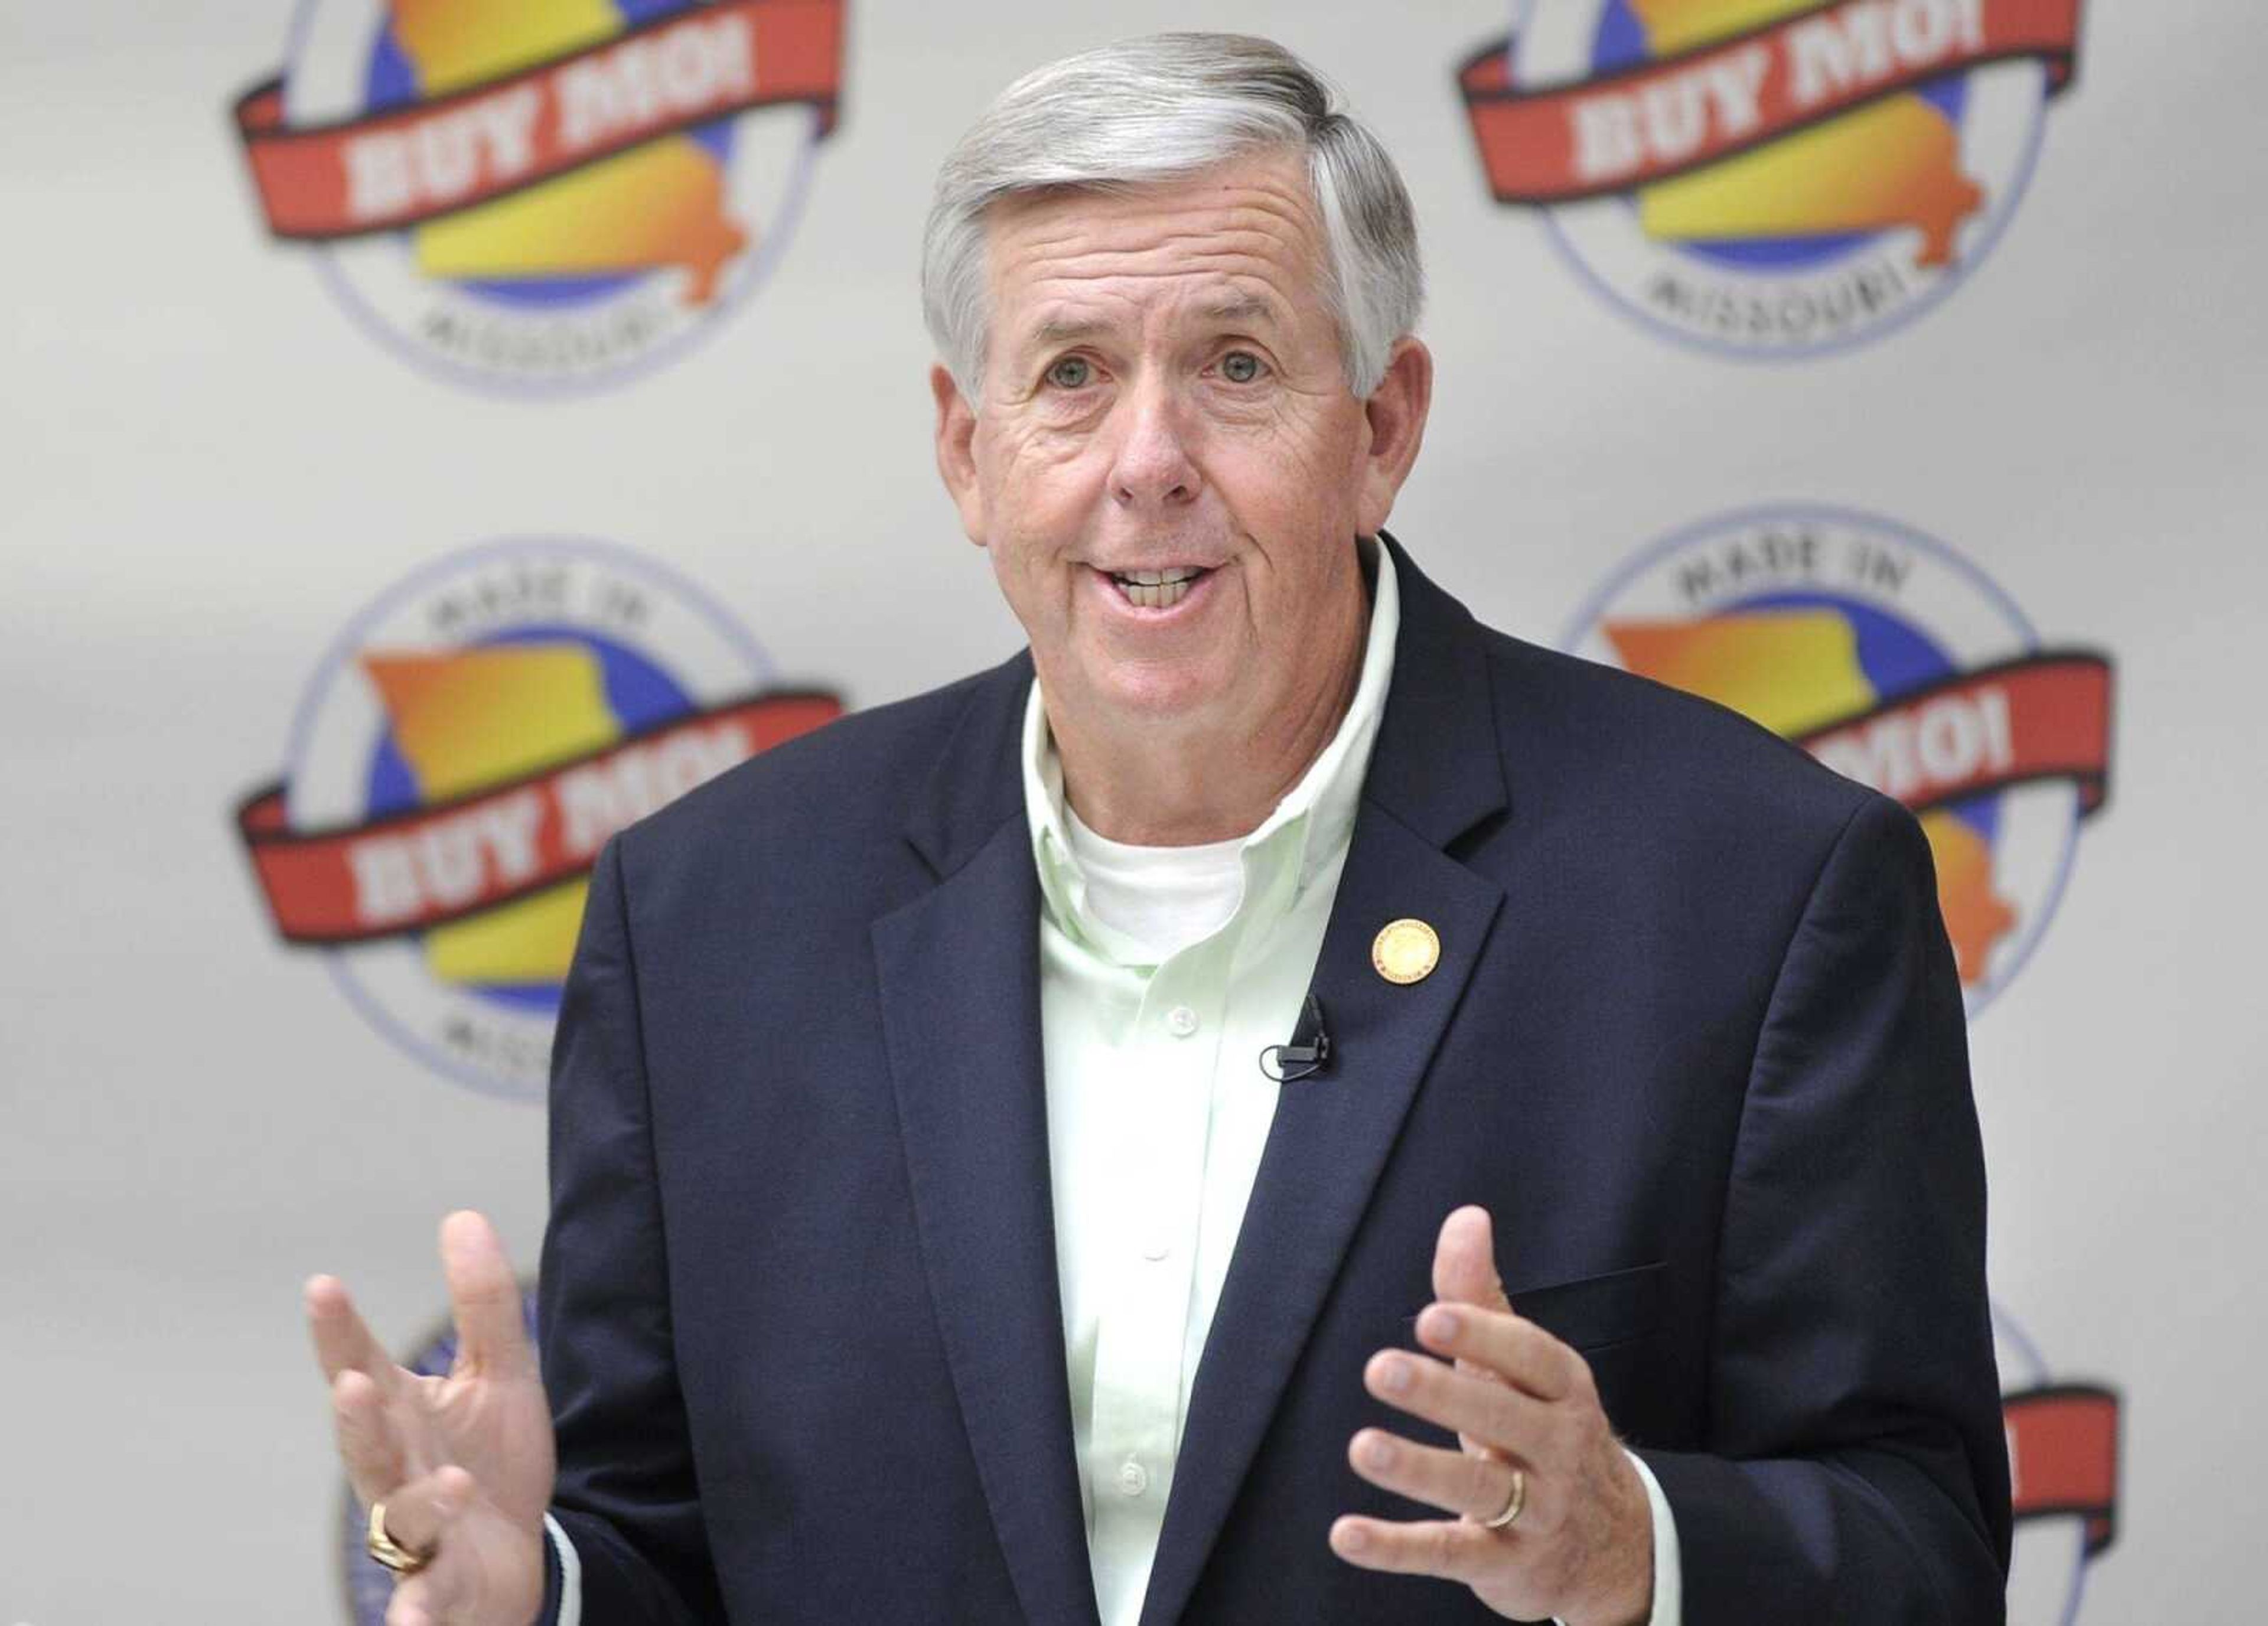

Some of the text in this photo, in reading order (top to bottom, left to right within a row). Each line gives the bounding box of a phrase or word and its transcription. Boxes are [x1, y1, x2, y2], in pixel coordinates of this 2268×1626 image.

[341, 11, 756, 222] BUY MO!
[1566, 50, 1768, 182] BUY
[1649, 260, 1909, 334] MISSOURI
[1679, 529, 1914, 604] MADE IN
[346, 797, 545, 925] BUY
